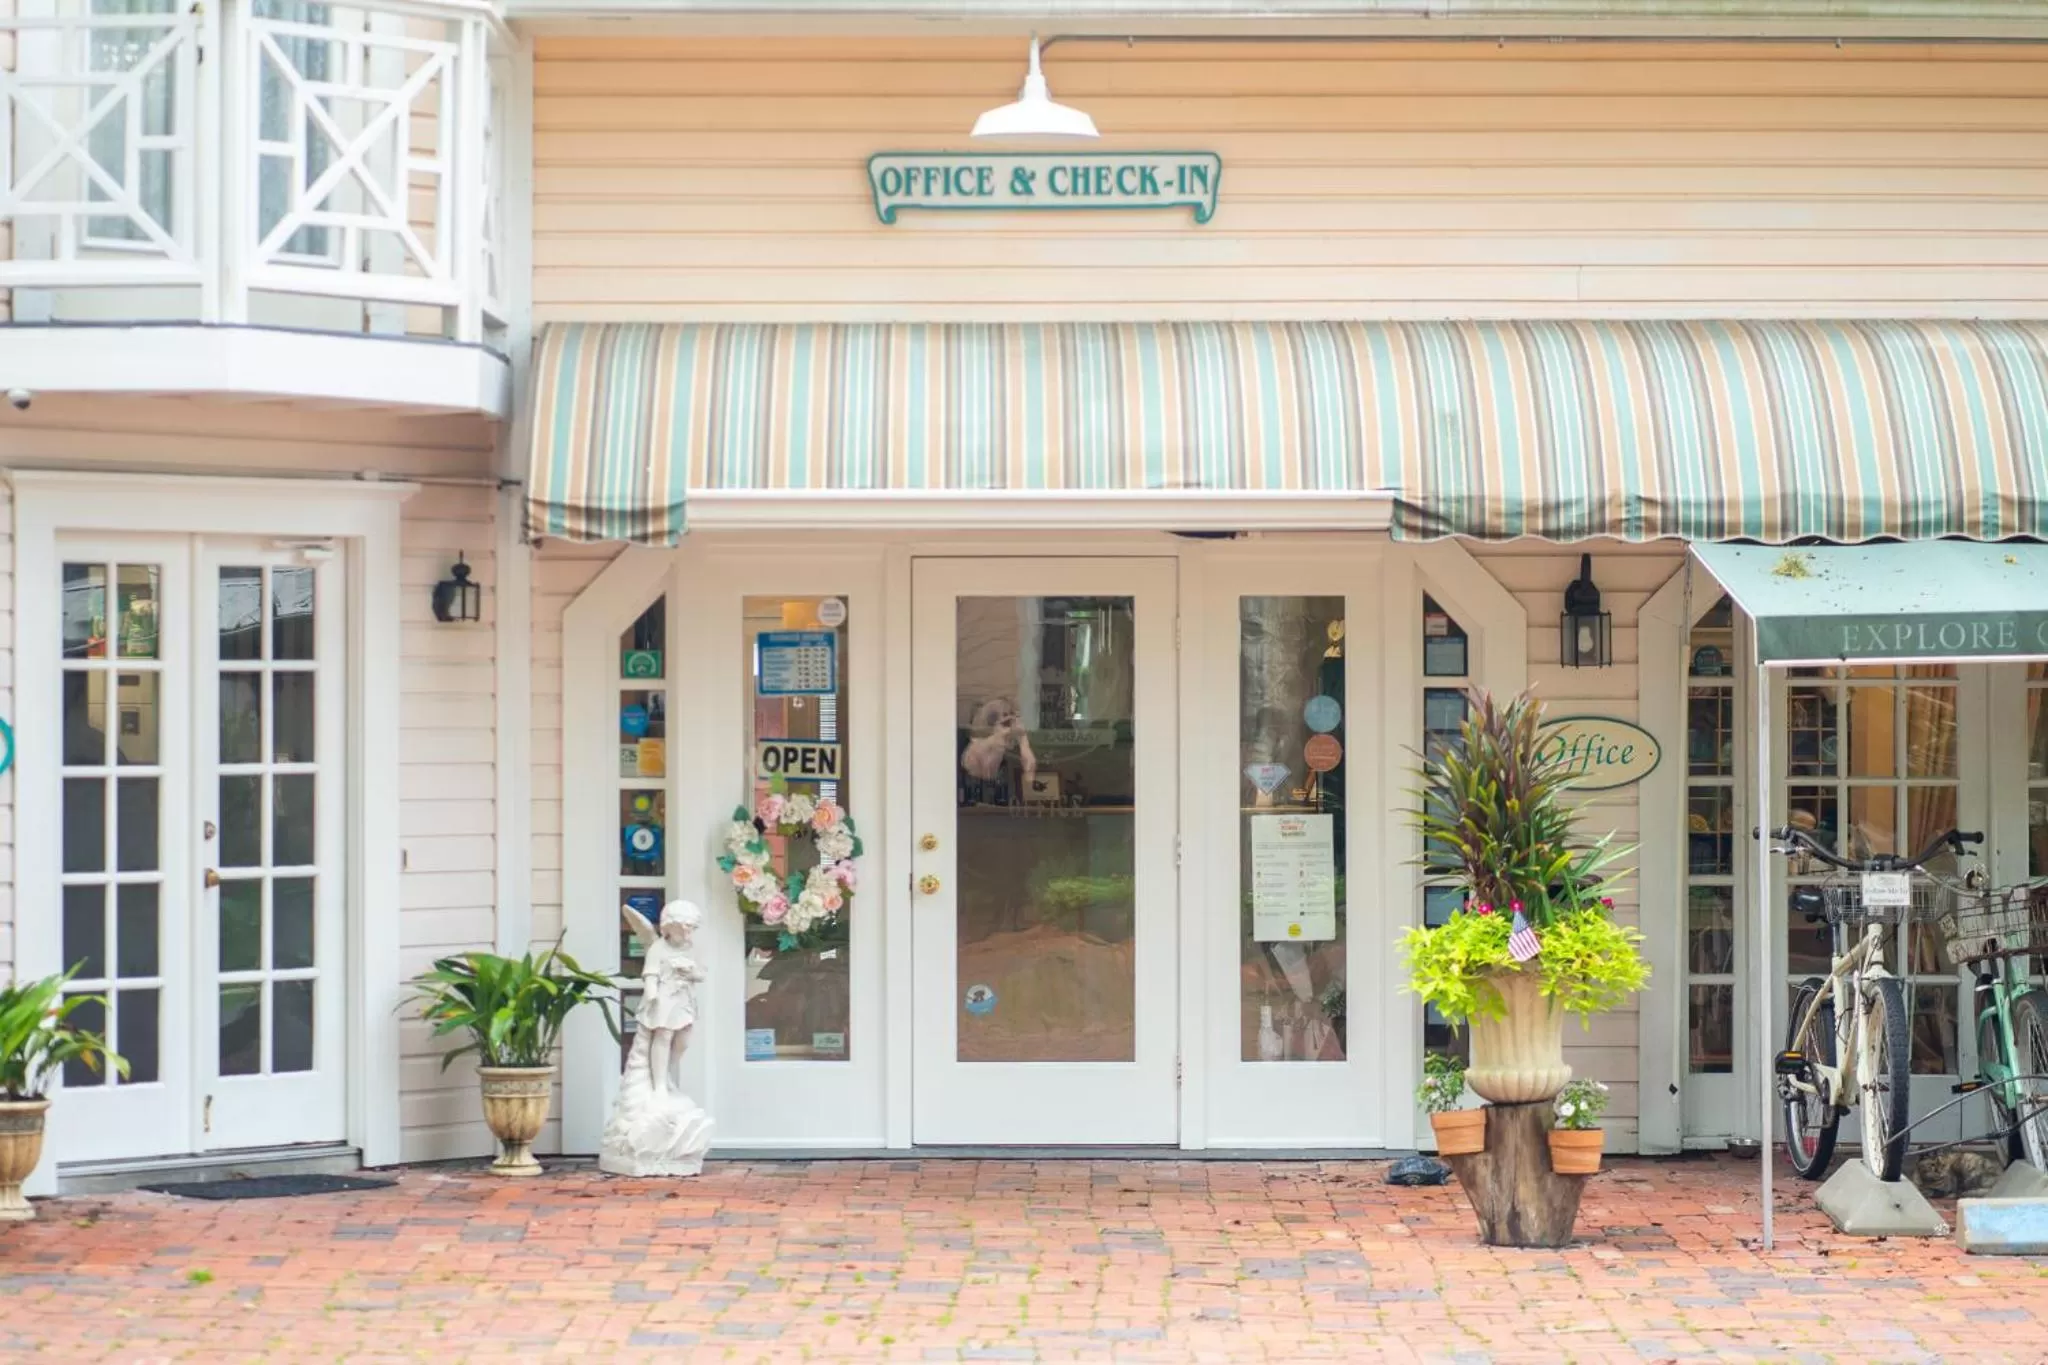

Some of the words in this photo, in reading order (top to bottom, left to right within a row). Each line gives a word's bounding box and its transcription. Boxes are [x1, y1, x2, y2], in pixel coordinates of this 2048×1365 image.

[879, 165, 995, 197] OFFICE
[1009, 165, 1037, 196] &
[1048, 164, 1211, 196] CHECK-IN
[1842, 620, 2018, 652] EXPLORE
[762, 745, 837, 775] OPEN
